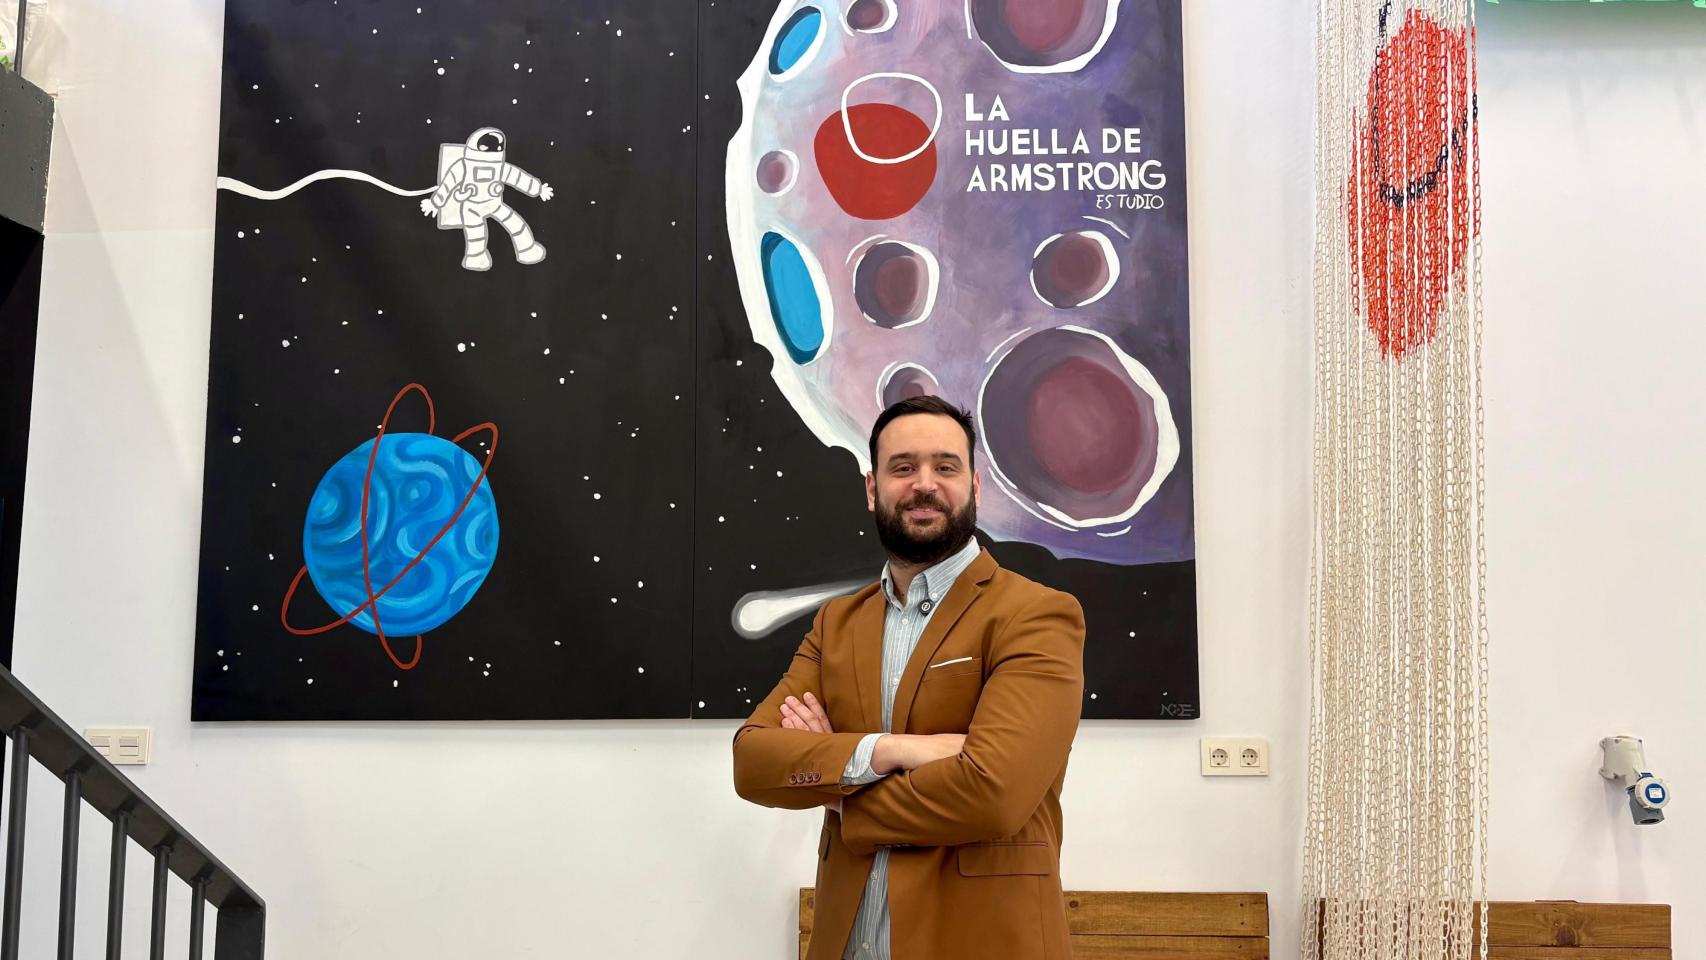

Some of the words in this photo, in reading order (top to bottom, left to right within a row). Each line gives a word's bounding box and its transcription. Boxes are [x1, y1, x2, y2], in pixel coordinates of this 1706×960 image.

[965, 93, 1010, 121] LA
[965, 128, 1090, 155] HUELLA
[1102, 127, 1141, 154] DE
[966, 159, 1167, 192] ARMSTRONG
[1095, 194, 1165, 210] ESTUDIO
